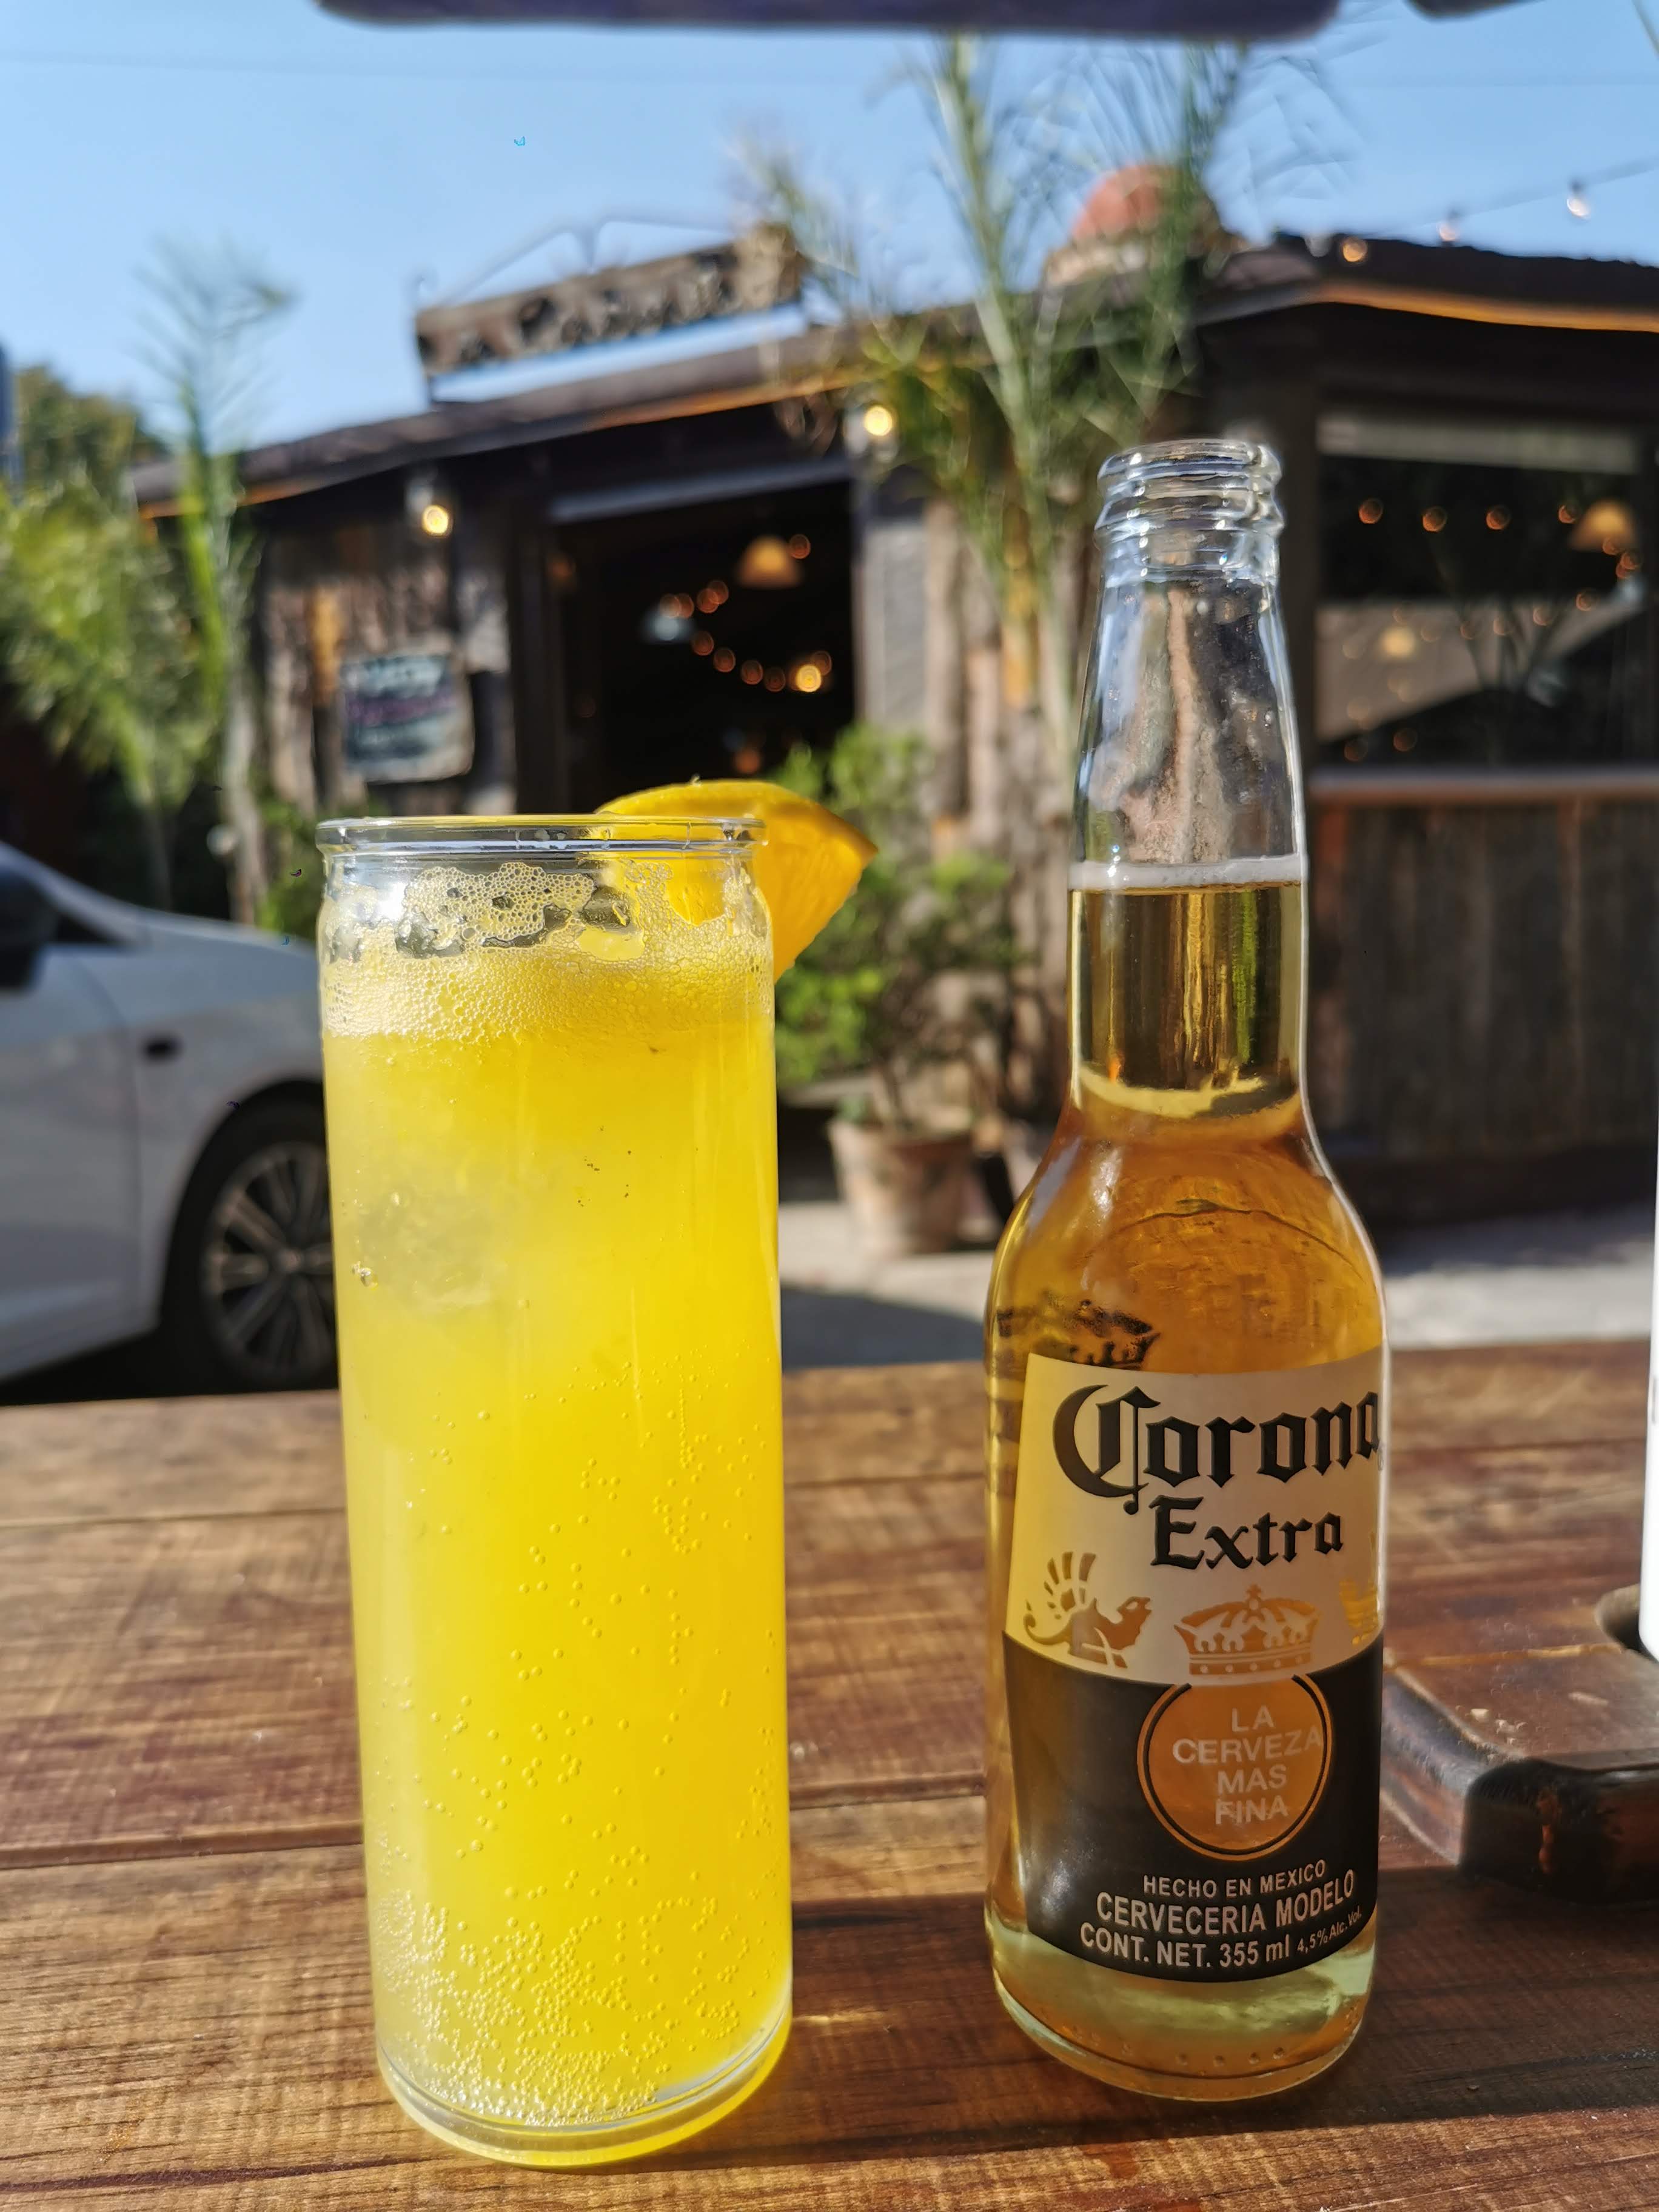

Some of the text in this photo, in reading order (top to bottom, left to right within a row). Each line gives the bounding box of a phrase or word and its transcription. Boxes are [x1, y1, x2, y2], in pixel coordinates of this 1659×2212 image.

[1052, 1384, 1380, 1515] Corona
[1148, 1495, 1344, 1569] Extra
[1232, 1704, 1275, 1732] LA
[1172, 1725, 1322, 1764] CERVEZA
[1217, 1764, 1287, 1794] MAS
[1215, 1795, 1289, 1825] FINA
[1143, 1859, 1325, 1898] HECHO EN MEXICO
[1096, 1868, 1355, 1936] CERVECERIA MODELO
[1080, 1922, 1150, 1962] CONT.
[1156, 1940, 1212, 1968] NET.
[1219, 1940, 1259, 1968] 355
[1265, 1933, 1290, 1962] ml
